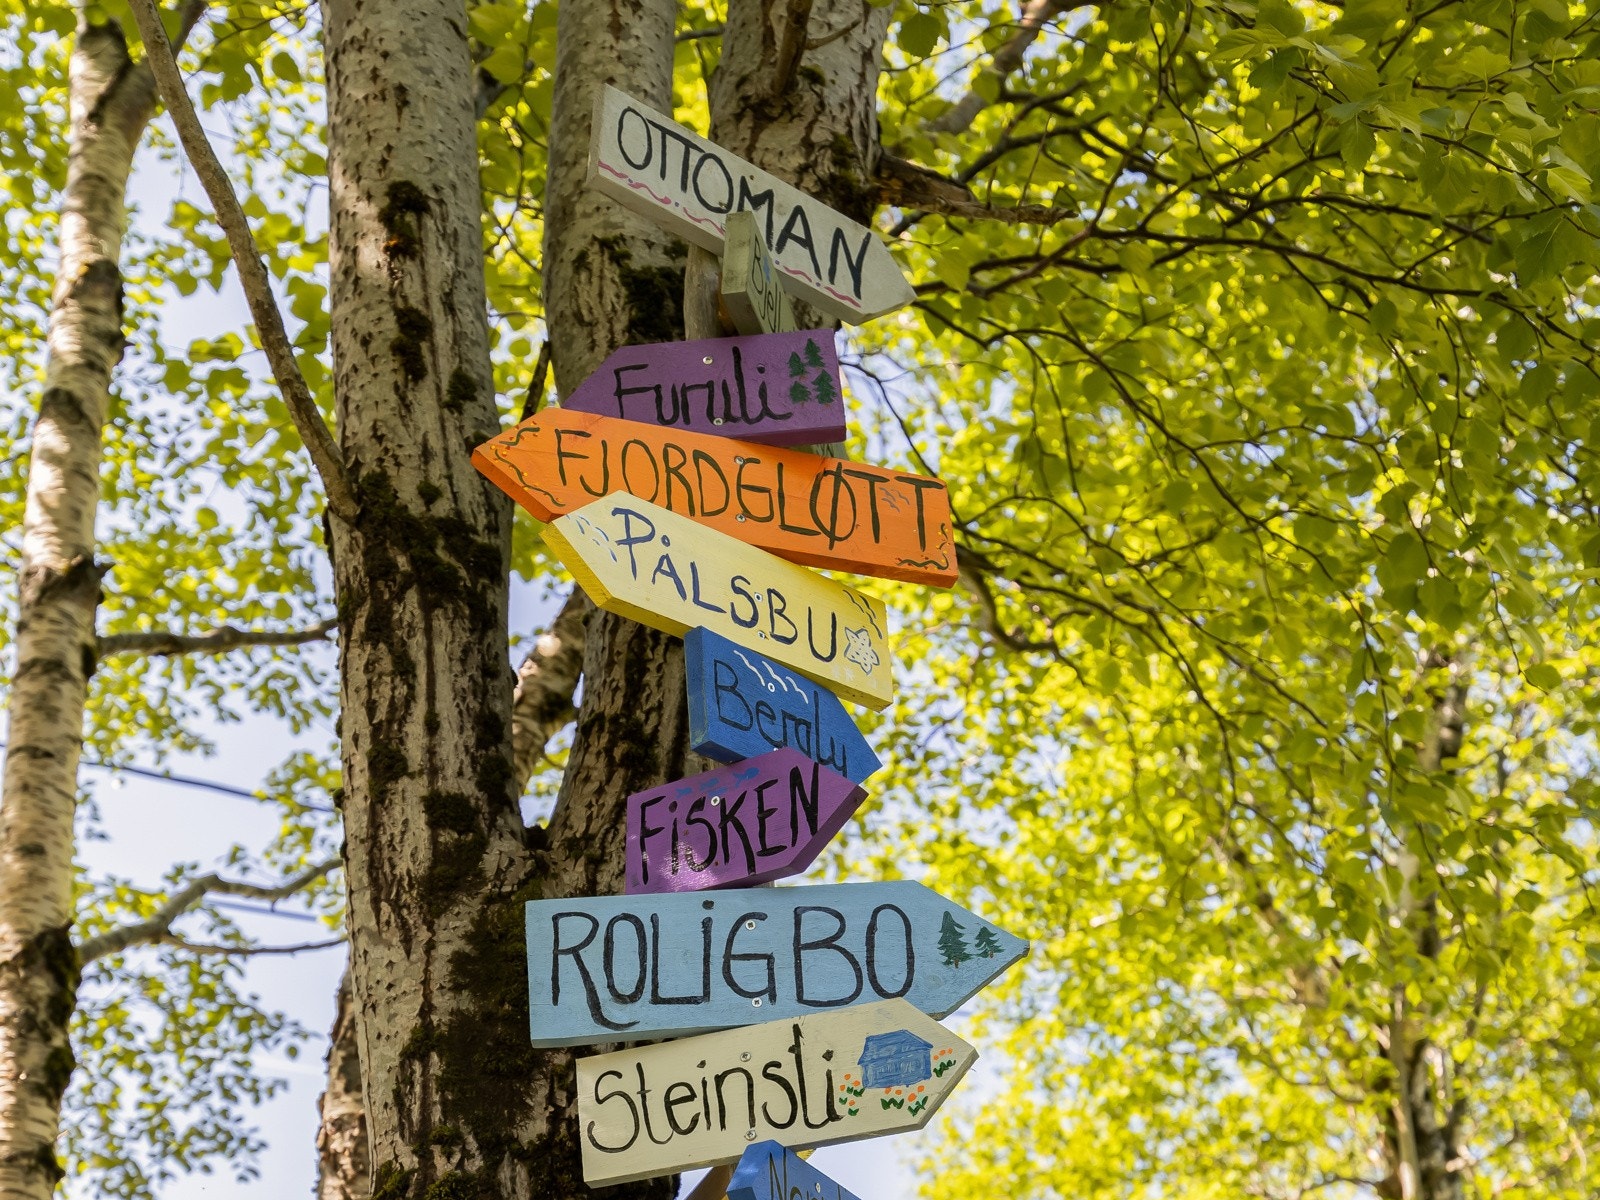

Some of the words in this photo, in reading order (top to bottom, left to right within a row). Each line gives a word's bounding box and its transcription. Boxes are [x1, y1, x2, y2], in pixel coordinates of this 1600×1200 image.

[618, 106, 872, 300] OTTOMAN
[614, 346, 793, 425] Furuli
[554, 428, 944, 551] FJORDGLØTT
[611, 507, 838, 663] PÅLSBU
[714, 659, 848, 777] Bergly
[587, 1023, 846, 1153] Steinsli
